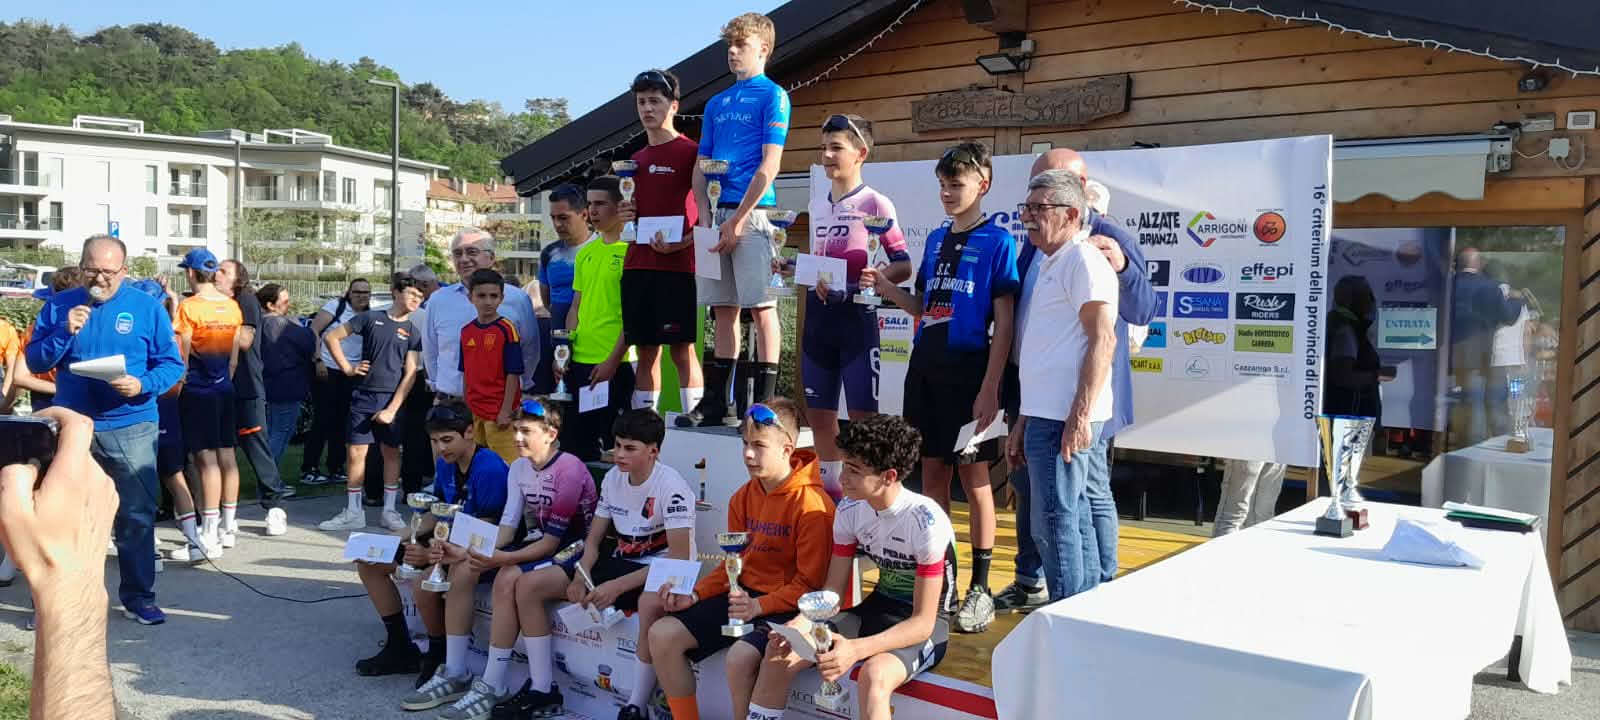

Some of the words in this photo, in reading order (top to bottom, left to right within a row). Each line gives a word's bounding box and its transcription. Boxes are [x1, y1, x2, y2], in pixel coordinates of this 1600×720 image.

[1138, 211, 1181, 231] ALZATE
[1198, 223, 1247, 234] ARRIGONI
[1139, 233, 1178, 247] BRIANZA
[1310, 207, 1324, 267] criterium
[1241, 262, 1294, 280] effepi
[1308, 270, 1323, 303] della
[1385, 319, 1431, 329] ENTRATA
[1305, 305, 1320, 366] provincia
[1305, 368, 1319, 382] di
[1303, 384, 1318, 420] Lecco
